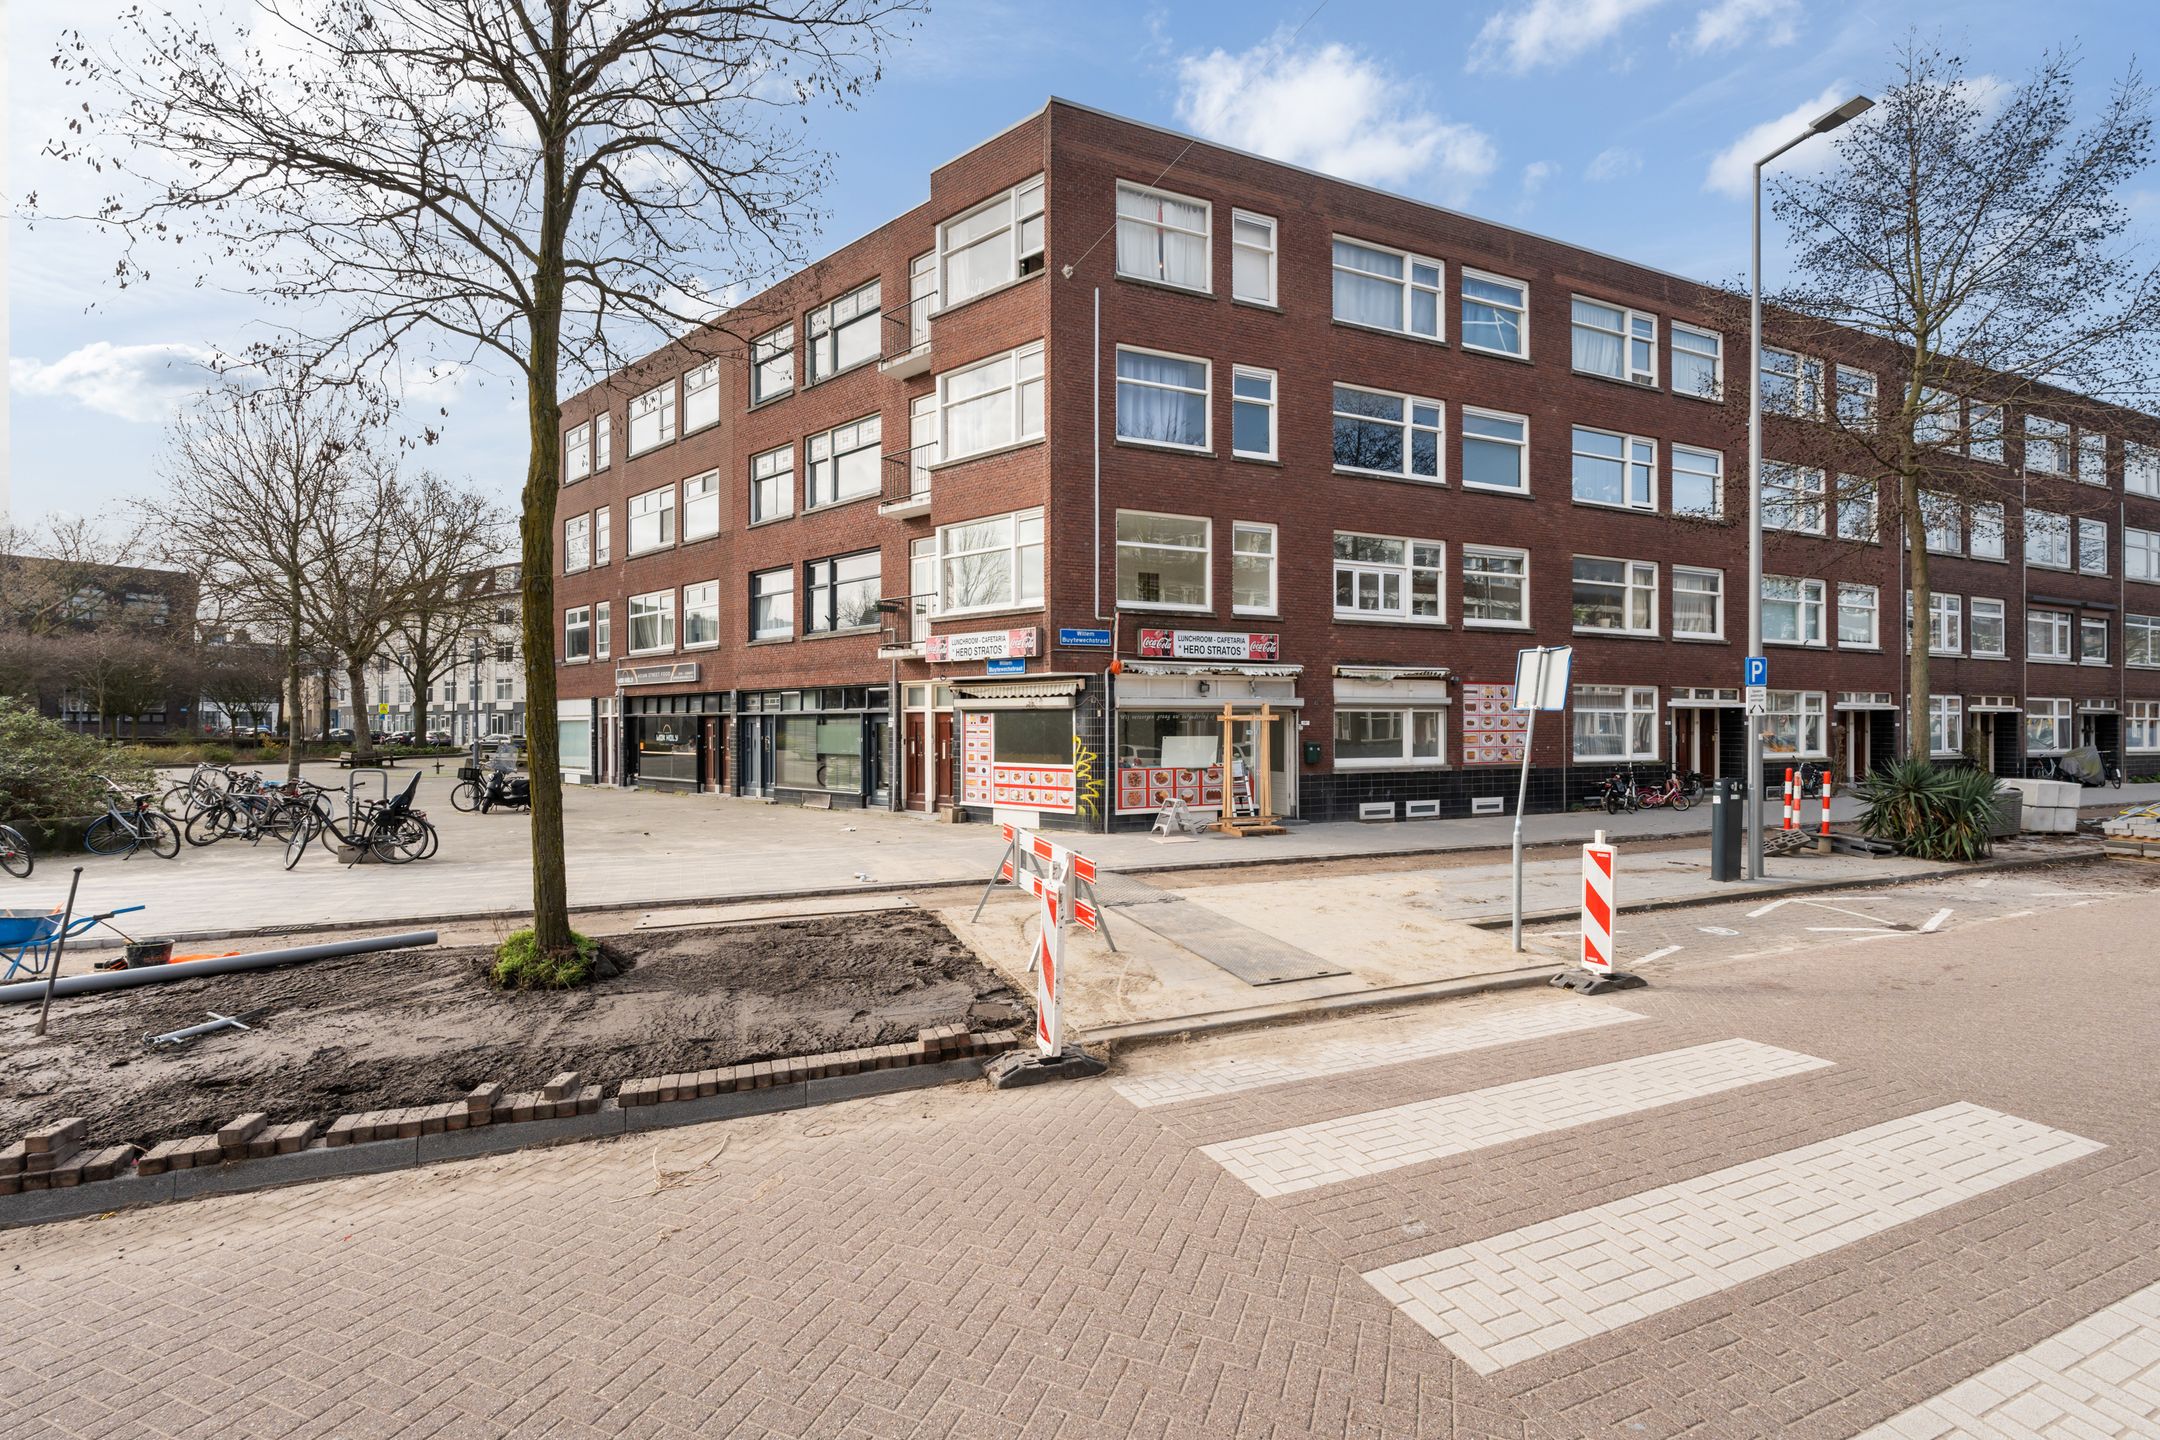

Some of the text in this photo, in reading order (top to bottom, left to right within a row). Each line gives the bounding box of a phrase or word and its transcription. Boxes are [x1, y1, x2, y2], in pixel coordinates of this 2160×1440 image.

[952, 637, 979, 646] LUNCHROOM
[981, 635, 1006, 643] CAFETARIA
[1177, 635, 1213, 643] LUNCHROOM
[1216, 636, 1246, 644] CAFETARIA
[956, 645, 1003, 656] HERO STRATOS
[1183, 645, 1242, 656] HERO STRATOS
[1751, 660, 1763, 683] P
